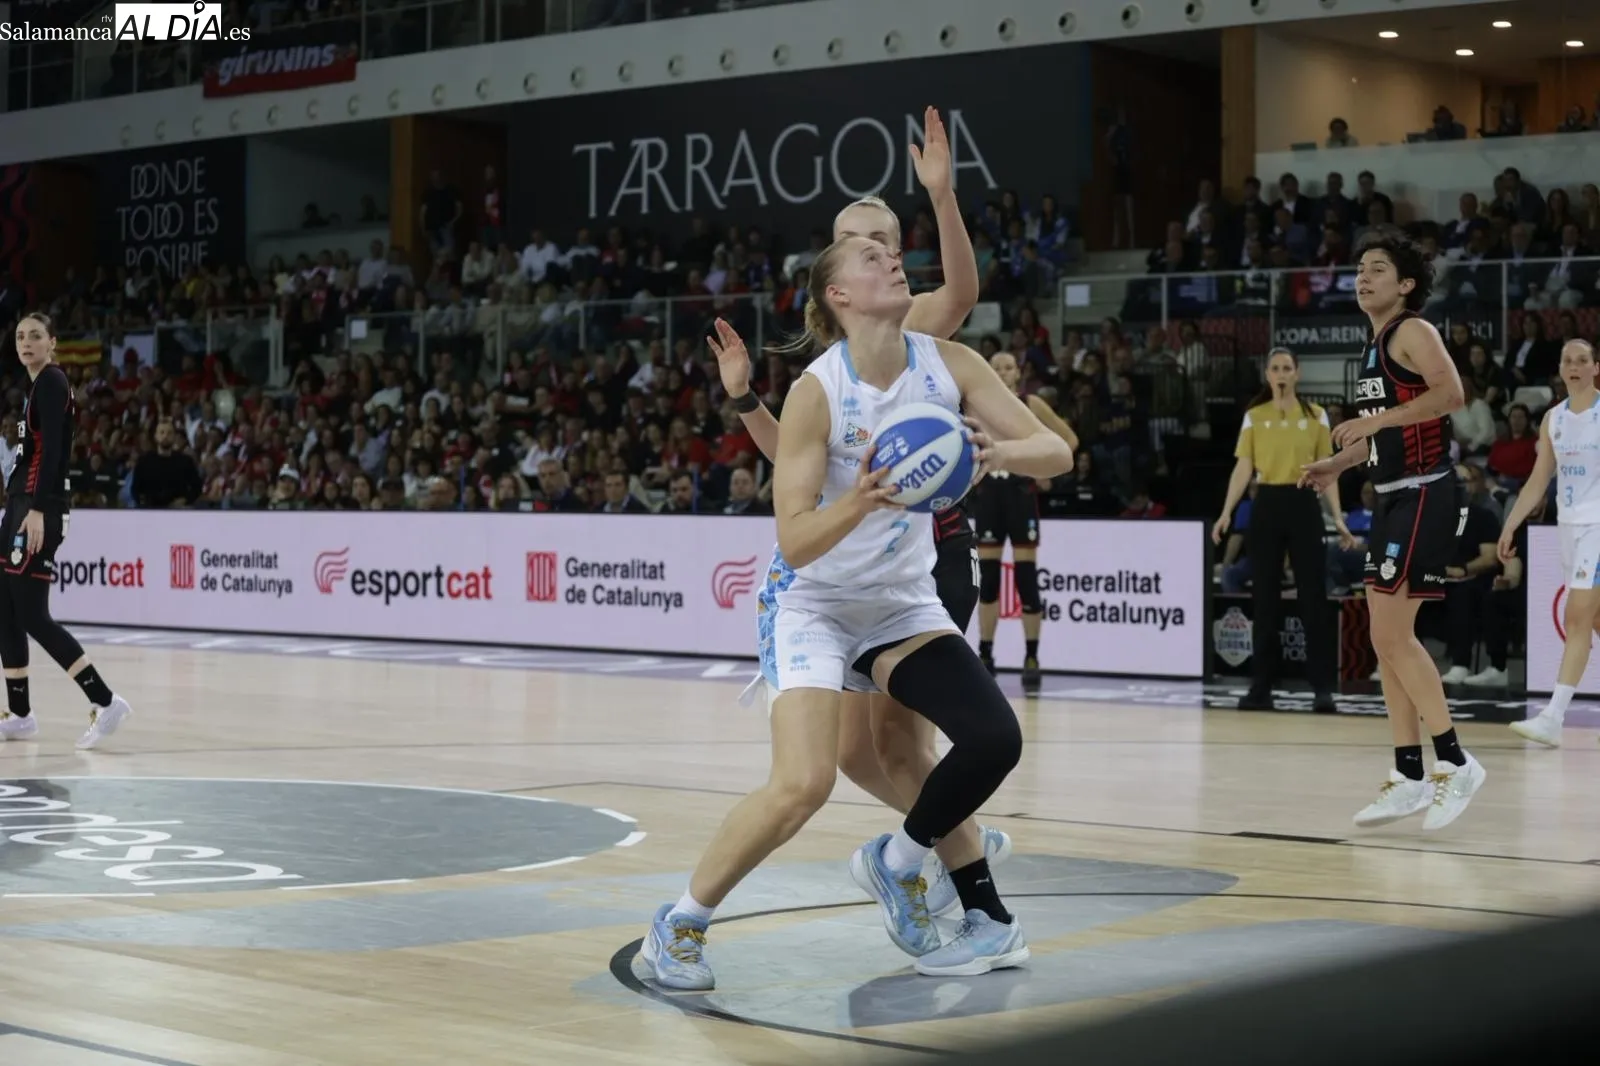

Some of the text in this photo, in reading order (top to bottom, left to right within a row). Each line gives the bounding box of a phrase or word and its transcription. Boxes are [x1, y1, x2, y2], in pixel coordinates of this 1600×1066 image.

[129, 156, 207, 200] DONDE
[572, 109, 997, 218] TARRAGONA
[115, 196, 220, 242] TODO ES
[1331, 325, 1368, 344] REIN
[890, 453, 948, 496] Wils
[1564, 485, 1574, 508] 3
[200, 548, 278, 570] Generalitat
[565, 556, 665, 581] Generalitat
[49, 557, 144, 593] sportcat
[200, 573, 293, 599] de Catalunya
[351, 565, 493, 607] esportcat
[1036, 568, 1161, 596] Generalitat
[565, 583, 684, 613] de Catalunya
[1068, 599, 1185, 632] Catalunya
